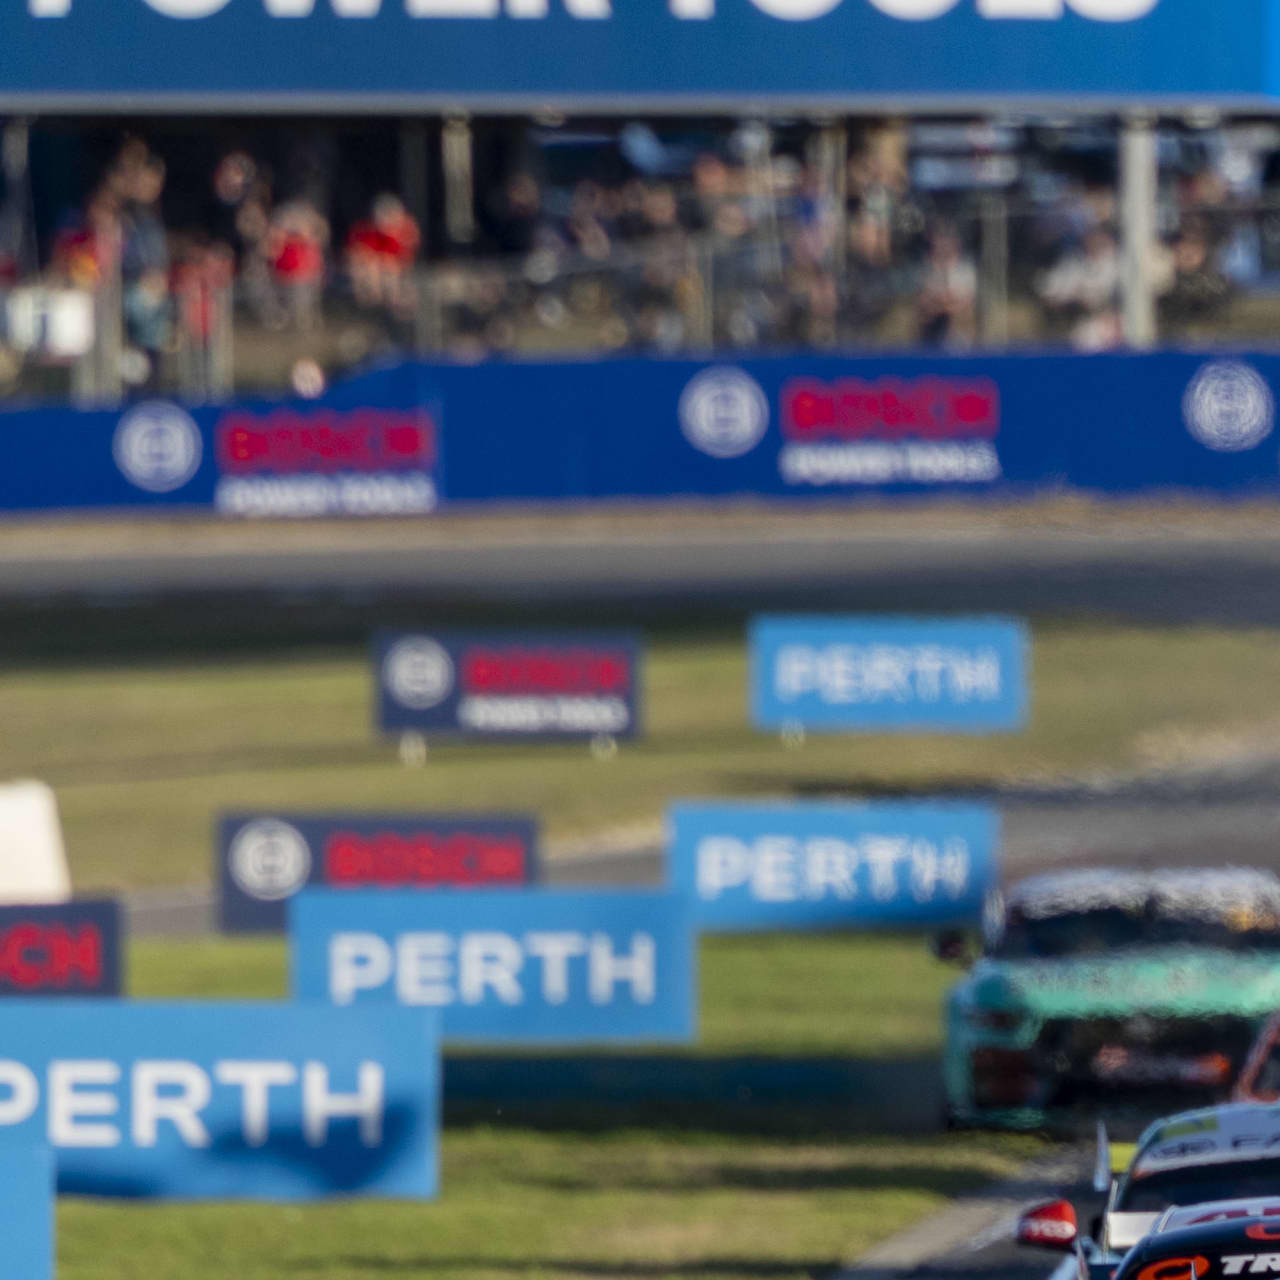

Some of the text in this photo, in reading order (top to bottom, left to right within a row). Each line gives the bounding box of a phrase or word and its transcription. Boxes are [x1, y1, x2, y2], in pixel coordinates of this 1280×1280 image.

[774, 643, 999, 702] PERTH
[695, 834, 970, 901] PERTH
[328, 931, 656, 1006] PERTH
[0, 1058, 385, 1148] PERTH
